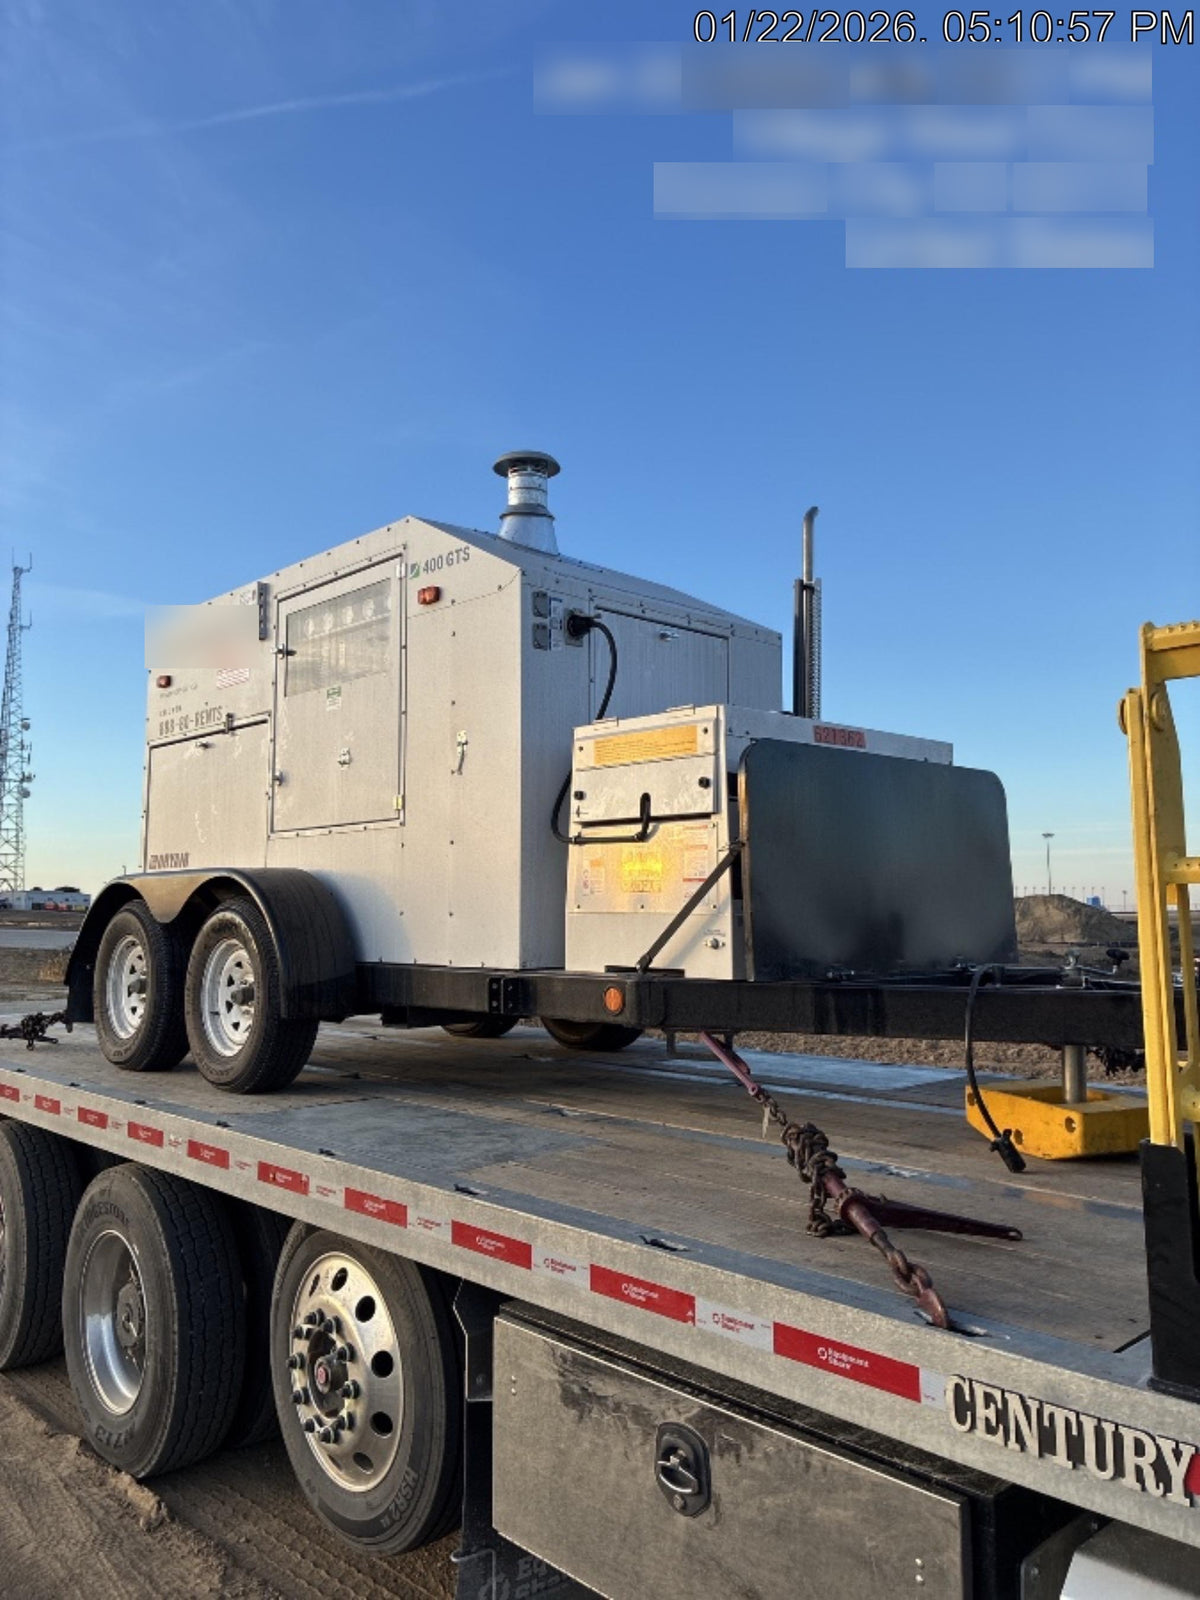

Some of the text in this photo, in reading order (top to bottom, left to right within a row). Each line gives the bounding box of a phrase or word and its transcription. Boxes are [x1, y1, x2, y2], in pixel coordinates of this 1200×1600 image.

[422, 546, 471, 574] 400 GTS
[945, 1374, 1197, 1508] CENTURY
